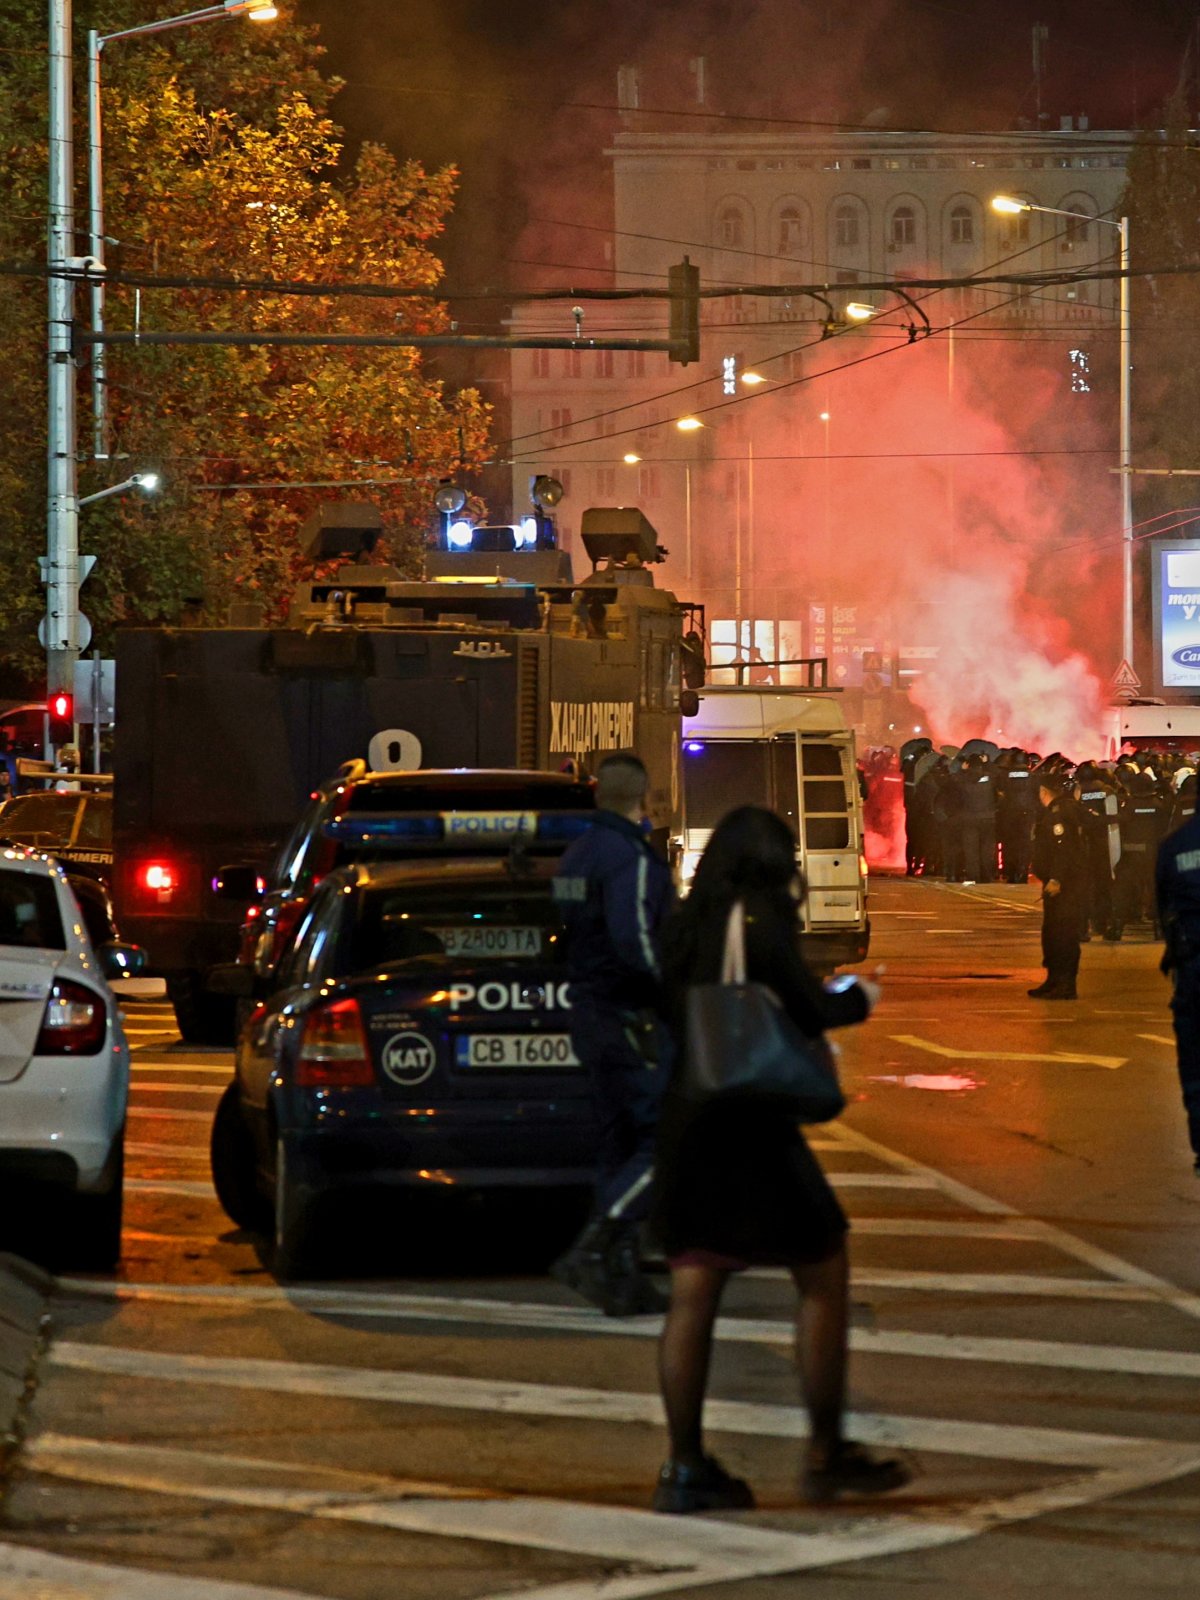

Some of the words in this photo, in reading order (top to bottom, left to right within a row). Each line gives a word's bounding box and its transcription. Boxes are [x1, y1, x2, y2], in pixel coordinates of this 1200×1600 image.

[550, 701, 634, 762] ЖАНДАРМЕРИЯ
[451, 816, 529, 833] POLICE
[513, 930, 537, 950] TA
[473, 1035, 505, 1062] CB
[514, 1034, 569, 1063] 1600
